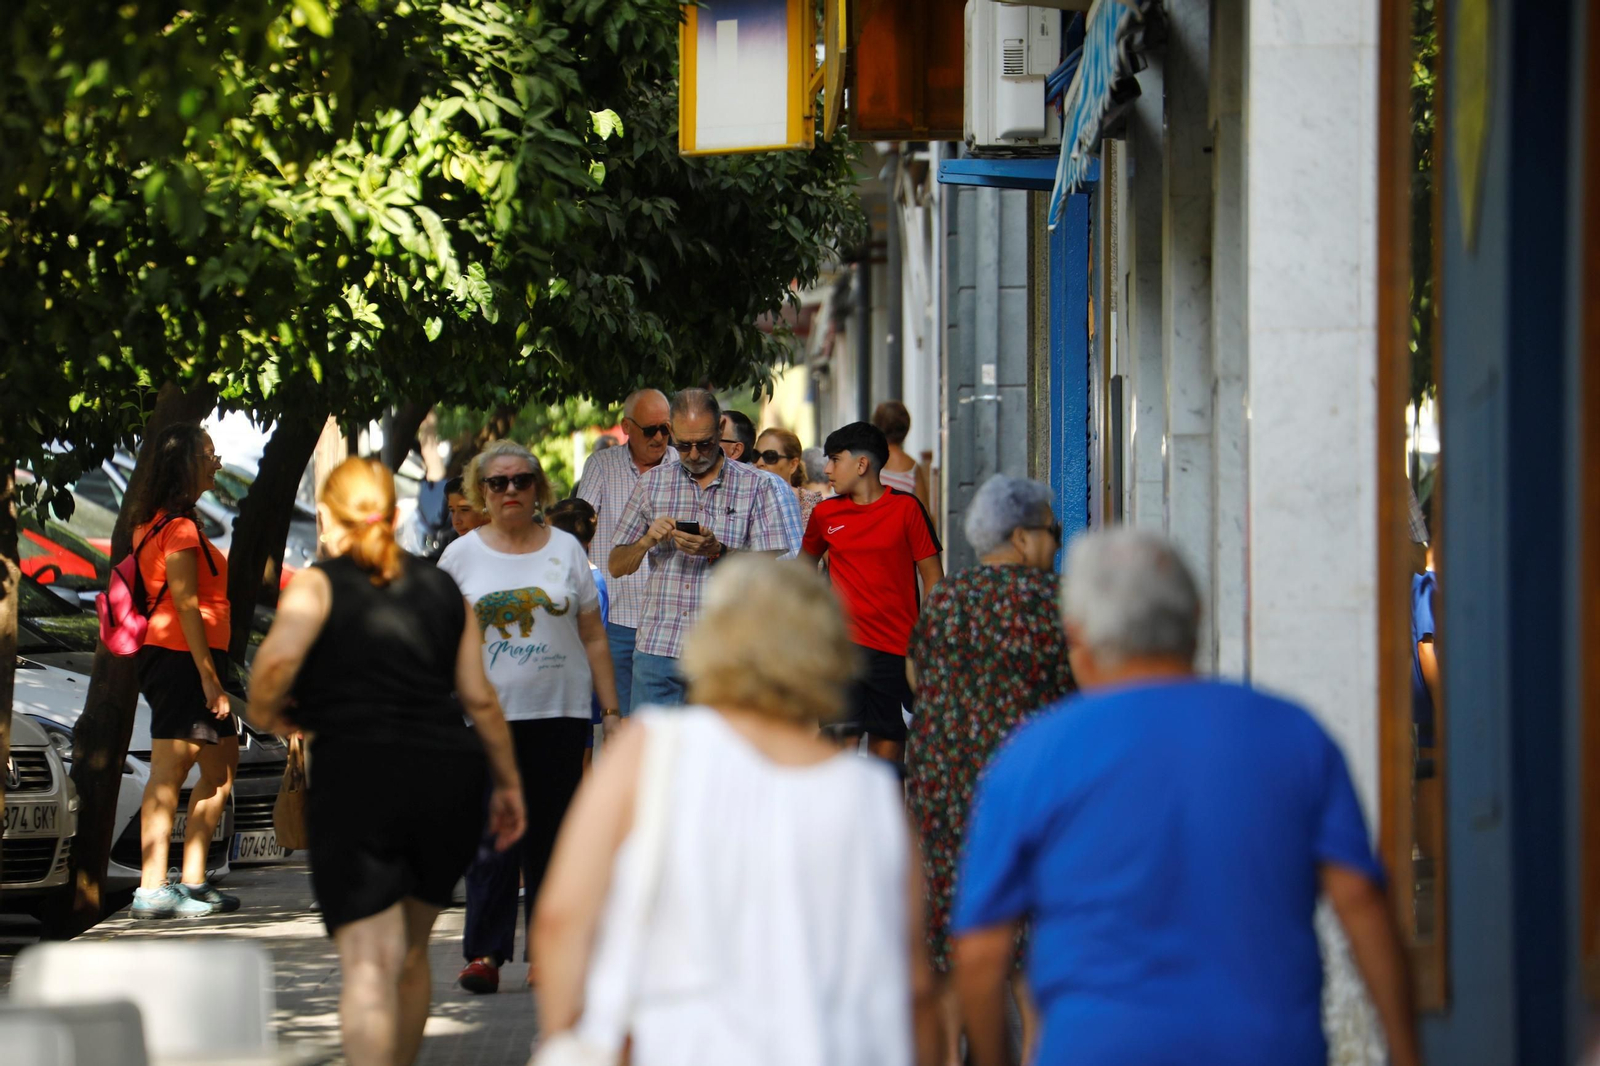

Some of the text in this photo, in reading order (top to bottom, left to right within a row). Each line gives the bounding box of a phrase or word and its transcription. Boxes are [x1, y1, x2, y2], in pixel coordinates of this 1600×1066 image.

[488, 640, 550, 670] Magic
[4, 805, 58, 830] 374 GKY
[240, 836, 266, 858] 0749
